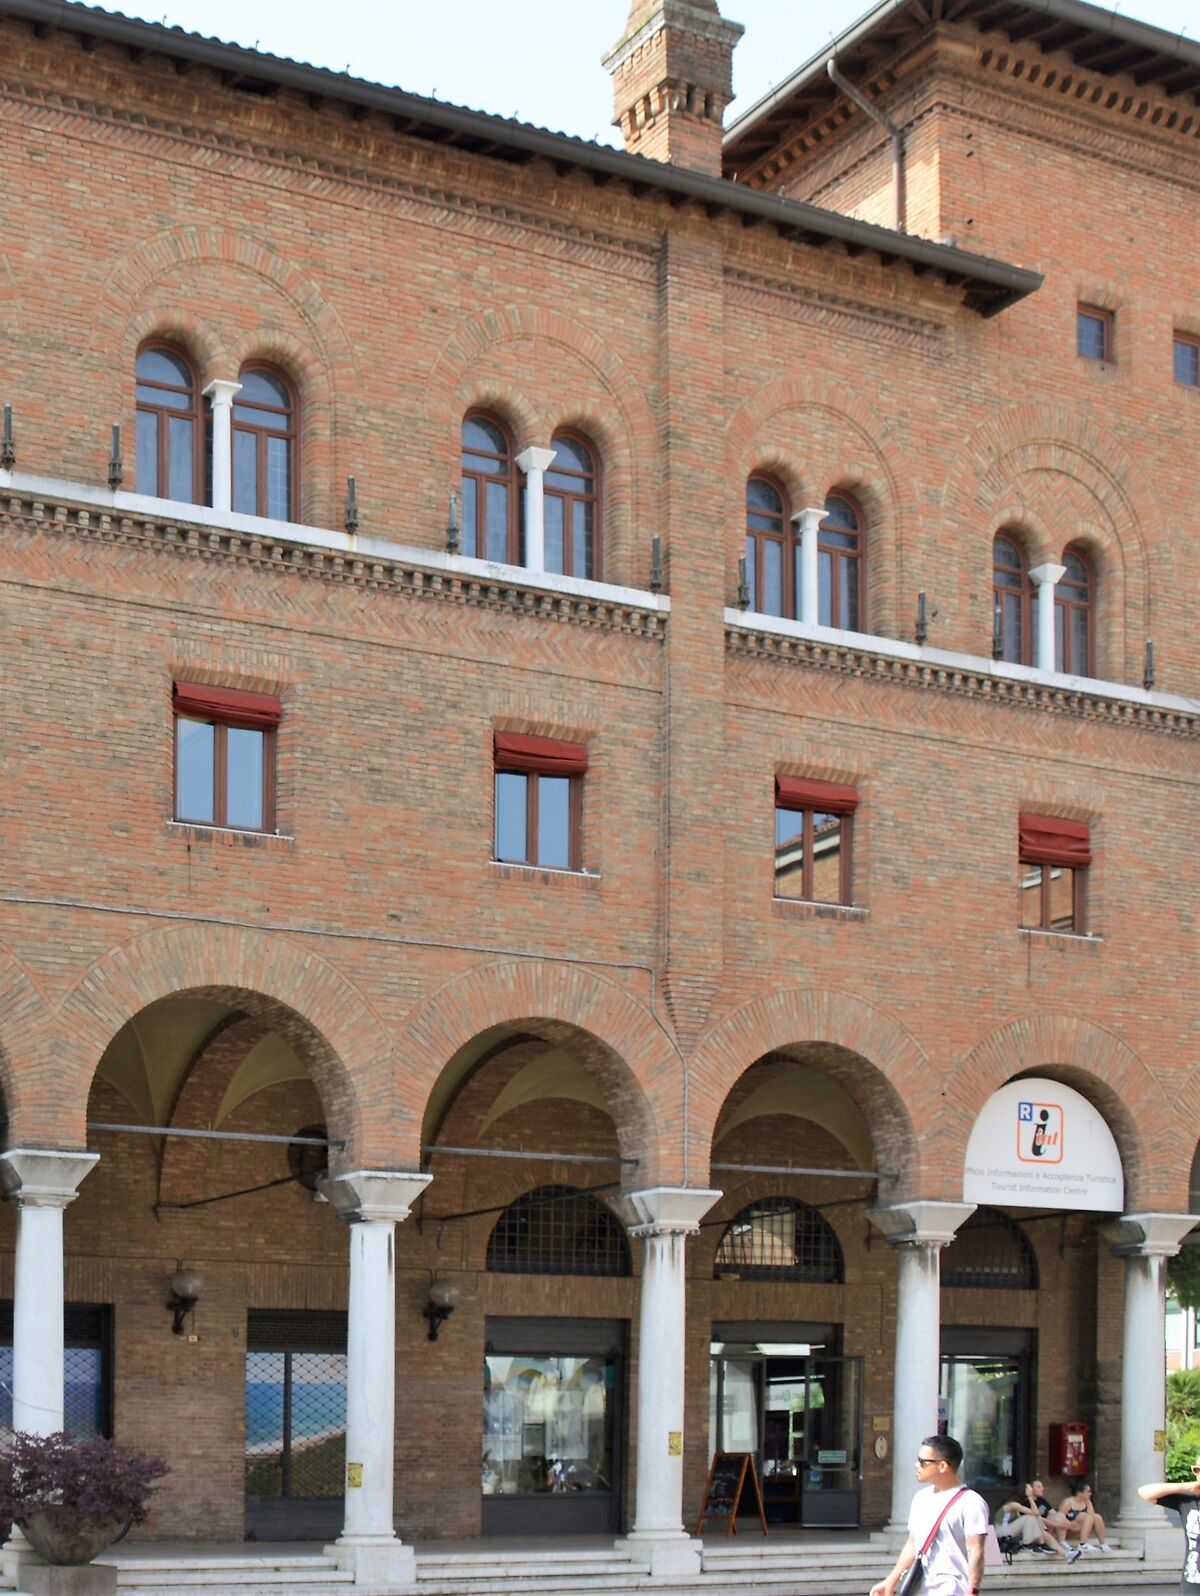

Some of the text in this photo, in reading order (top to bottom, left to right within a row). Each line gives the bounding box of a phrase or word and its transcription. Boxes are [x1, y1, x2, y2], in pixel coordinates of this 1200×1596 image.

[1020, 1103, 1031, 1120] R
[987, 1167, 1033, 1179] Informazioni
[1042, 1171, 1085, 1182] Accoglienza
[1086, 1174, 1117, 1184] Turistica
[992, 1182, 1088, 1196] Tourist Information Centre
